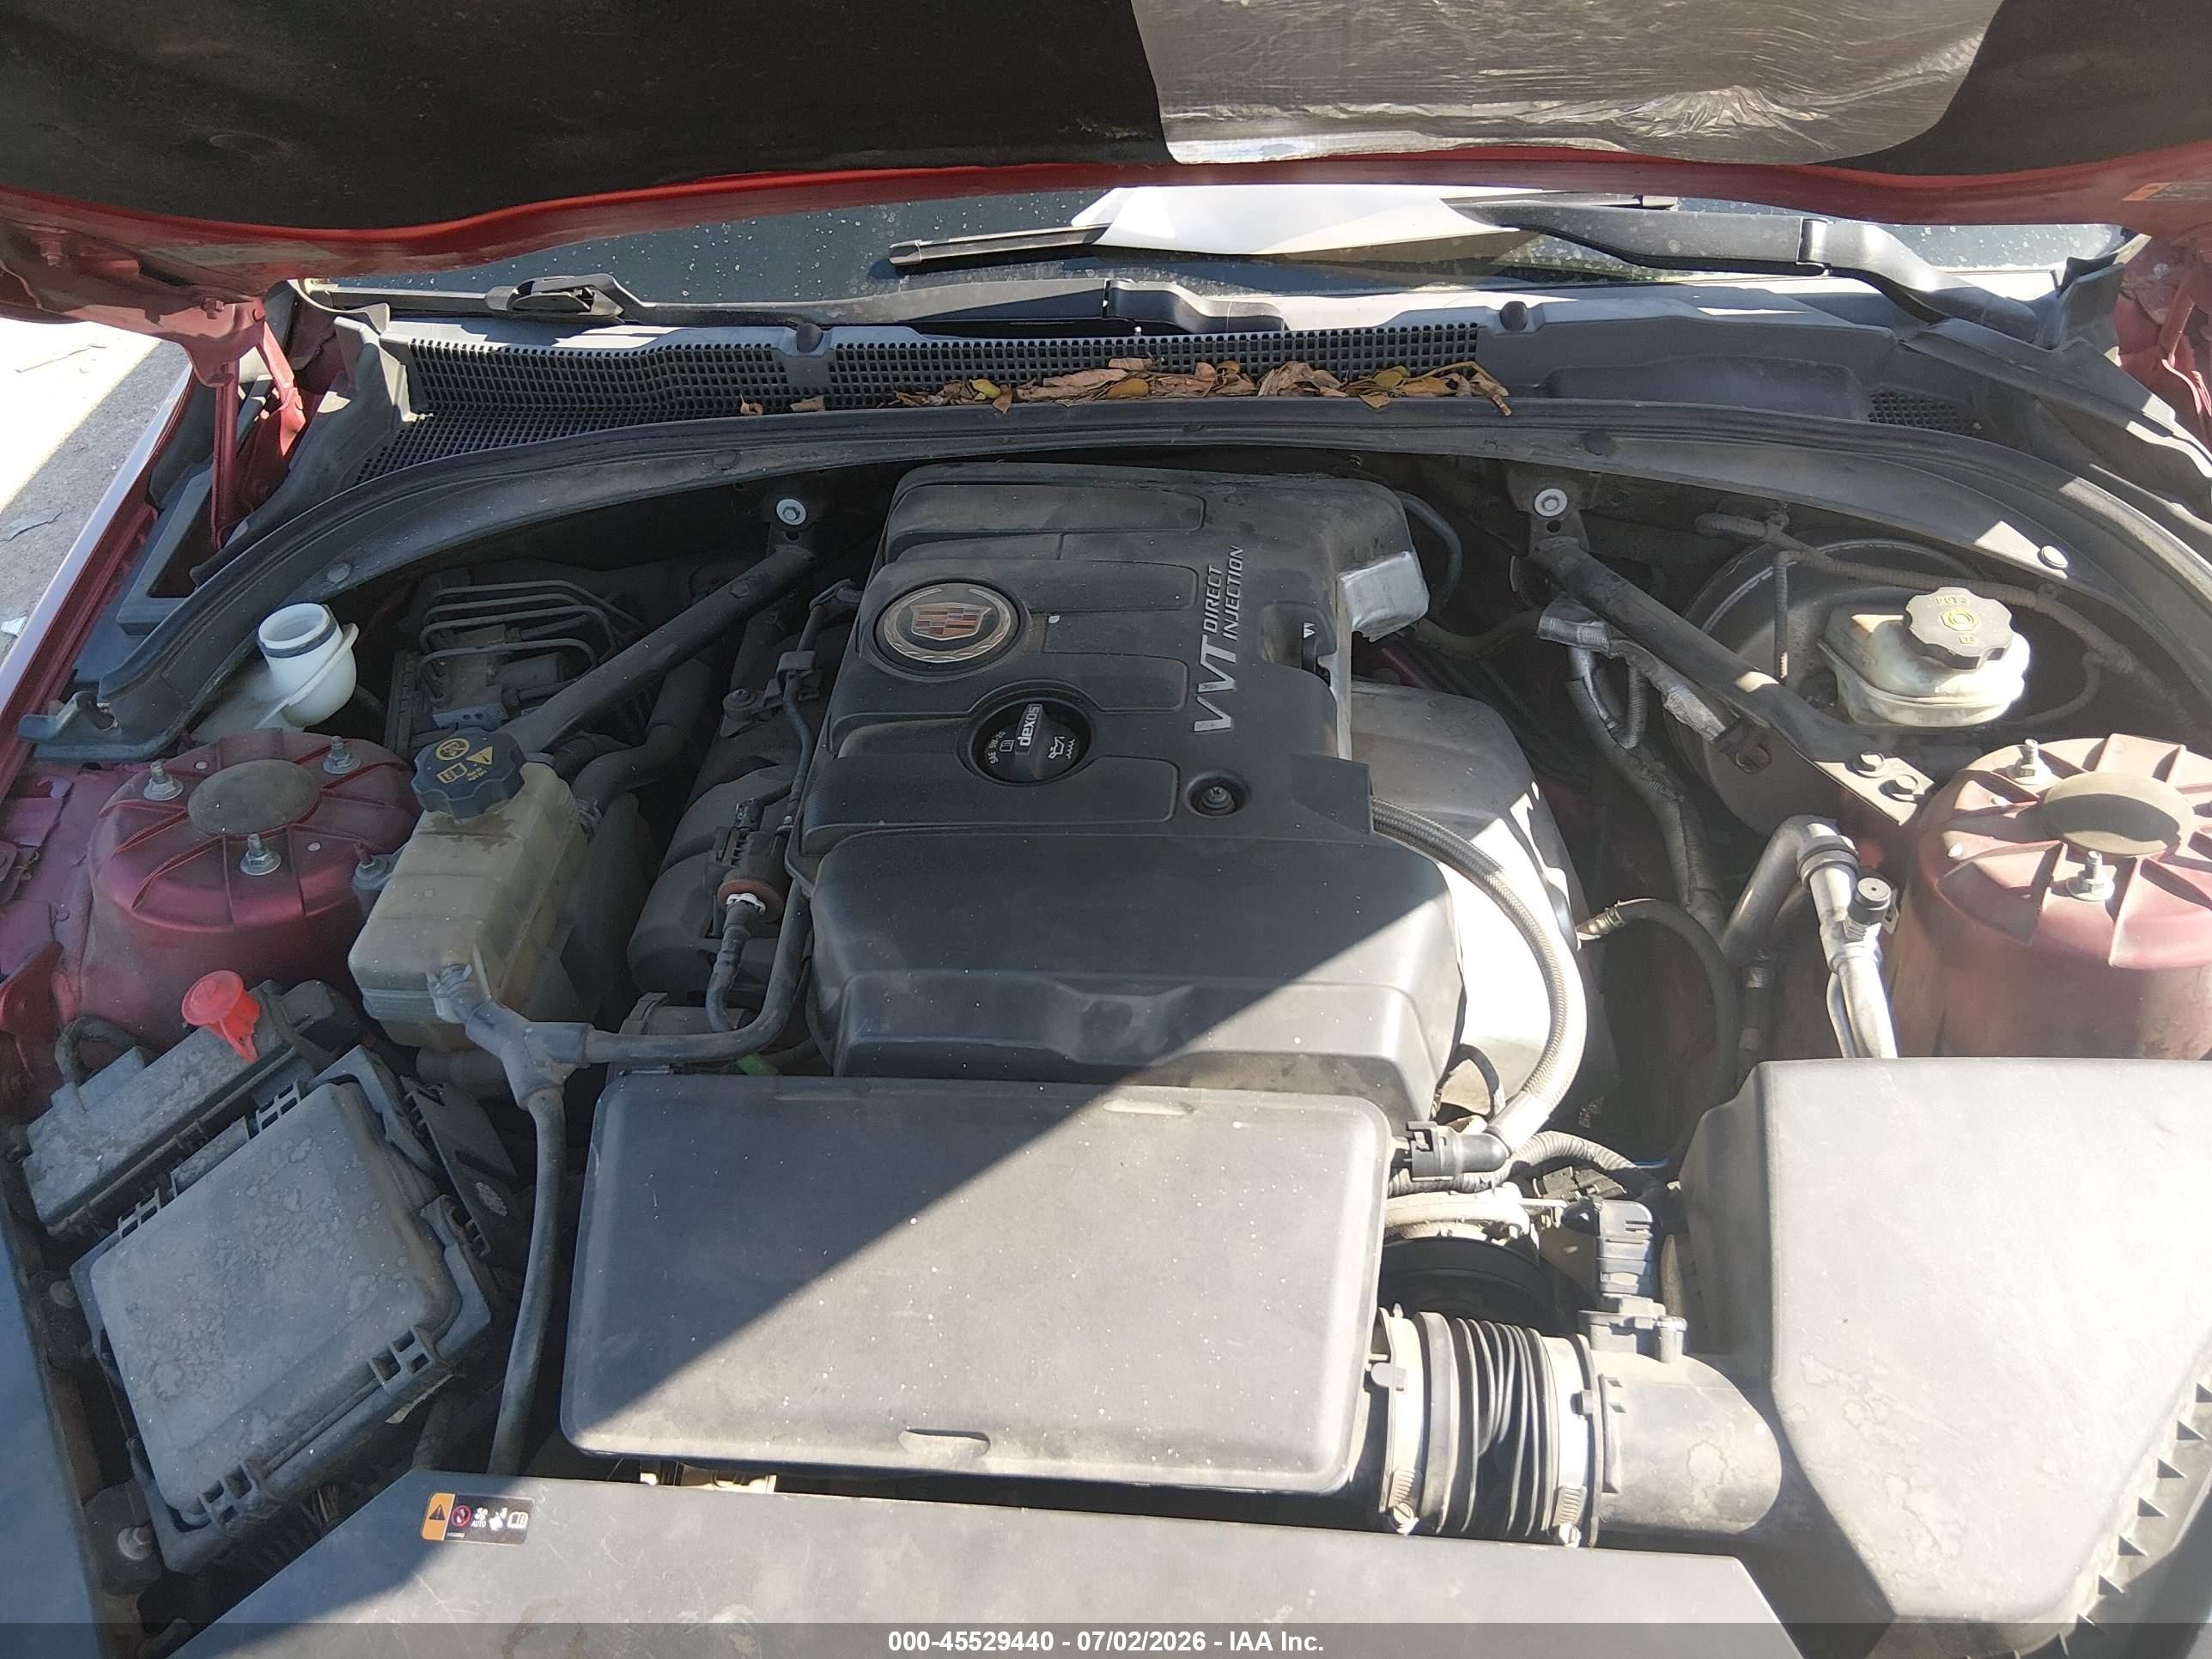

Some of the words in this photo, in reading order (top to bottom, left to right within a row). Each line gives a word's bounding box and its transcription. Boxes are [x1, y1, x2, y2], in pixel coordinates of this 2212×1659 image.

[1203, 565, 1223, 634] DIRECT
[1223, 545, 1243, 641] INJECTION
[1194, 634, 1236, 732] VVT
[1018, 706, 1040, 746] dexos
